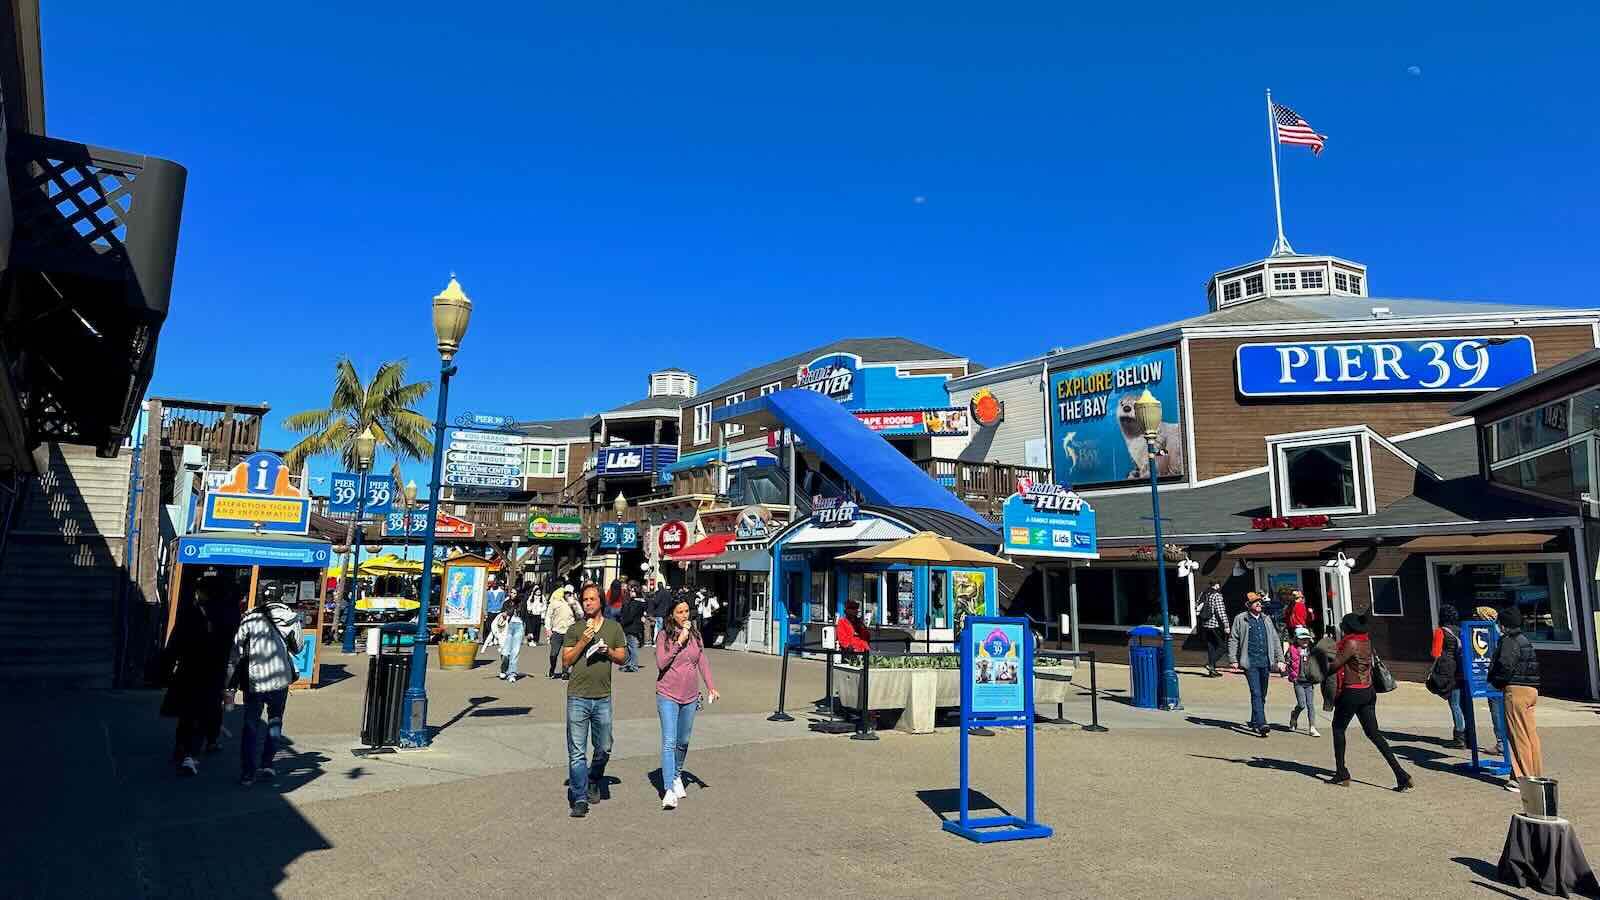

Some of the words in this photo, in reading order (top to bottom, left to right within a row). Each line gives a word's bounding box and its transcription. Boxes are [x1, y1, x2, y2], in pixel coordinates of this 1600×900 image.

[1276, 344, 1410, 383] PIER
[1419, 341, 1490, 388] 39
[1058, 372, 1112, 399] EXPLORE
[1116, 361, 1162, 388] BELOW
[1059, 400, 1081, 421] THE
[1084, 395, 1107, 417] BAY
[475, 415, 494, 424] PIER
[859, 417, 881, 425] APE
[883, 416, 914, 425] ROOMS
[607, 452, 640, 468] Lids
[456, 464, 487, 472] WELCOME
[335, 479, 354, 487] PIER
[370, 481, 389, 489] PIER
[332, 487, 355, 505] 39
[367, 489, 390, 506] 39
[1036, 495, 1082, 511] FLYER
[238, 510, 299, 518] INFORMATION
[820, 508, 853, 522] FLYER
[388, 518, 403, 531] 39
[412, 519, 427, 531] 39
[603, 532, 616, 543] 39
[622, 532, 635, 543] 39
[1055, 533, 1068, 542] Lids
[993, 646, 1003, 655] 39
